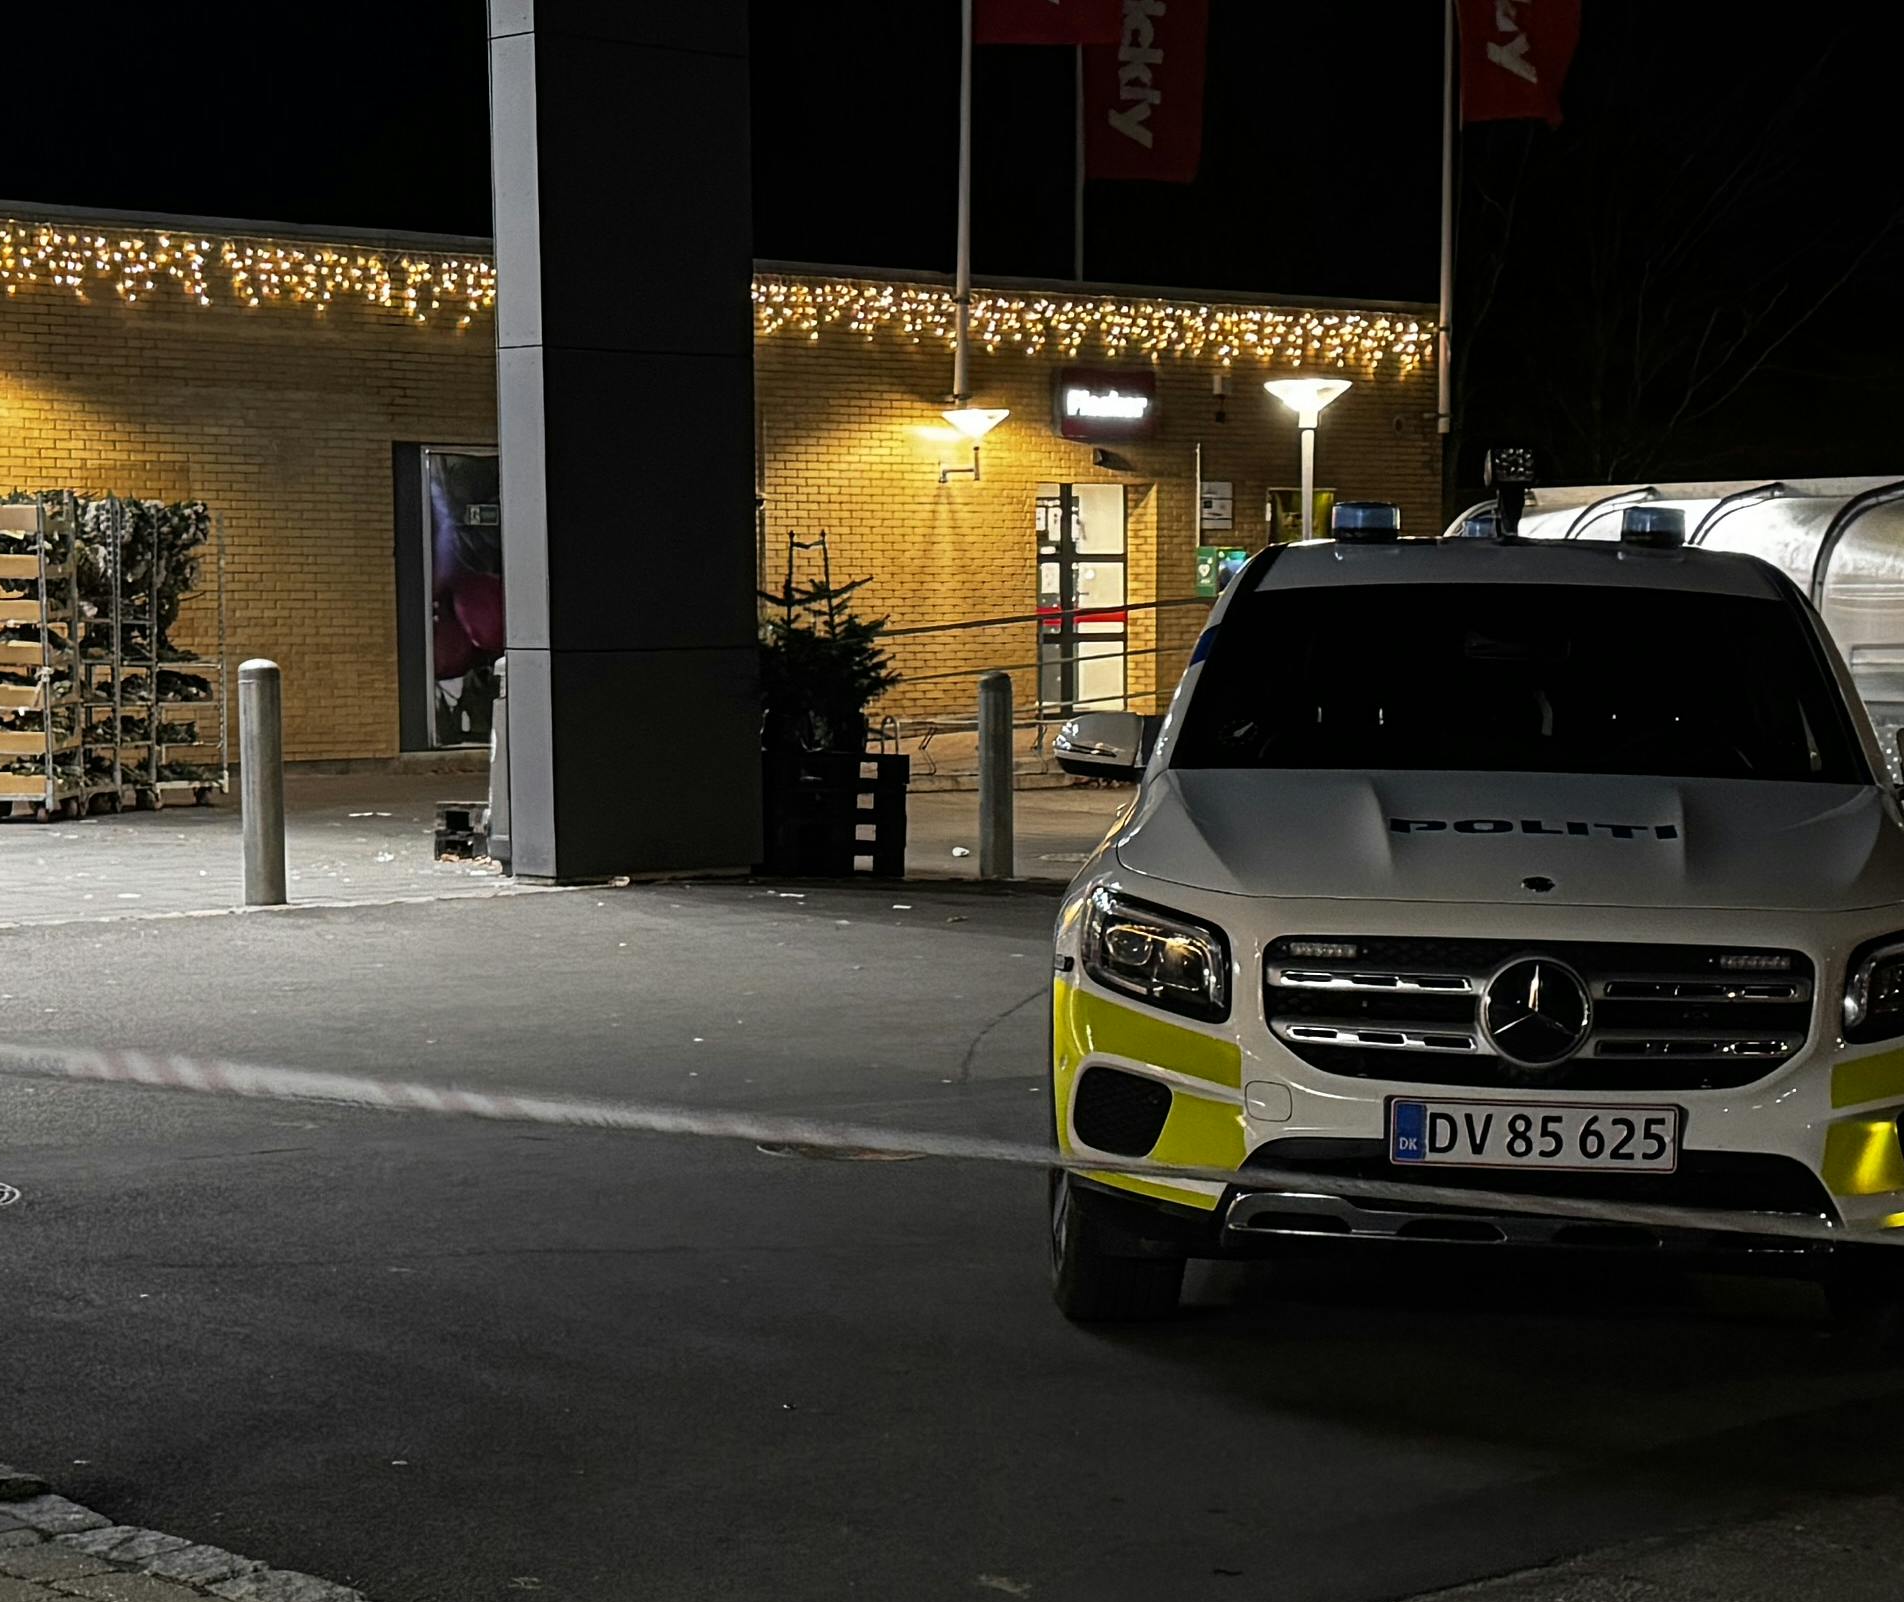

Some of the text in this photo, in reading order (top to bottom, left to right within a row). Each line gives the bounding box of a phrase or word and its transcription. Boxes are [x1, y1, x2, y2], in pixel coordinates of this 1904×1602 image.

[1390, 818, 1678, 839] POLITI
[1399, 1136, 1418, 1150] DK
[1428, 1111, 1667, 1161] DV 85 625
